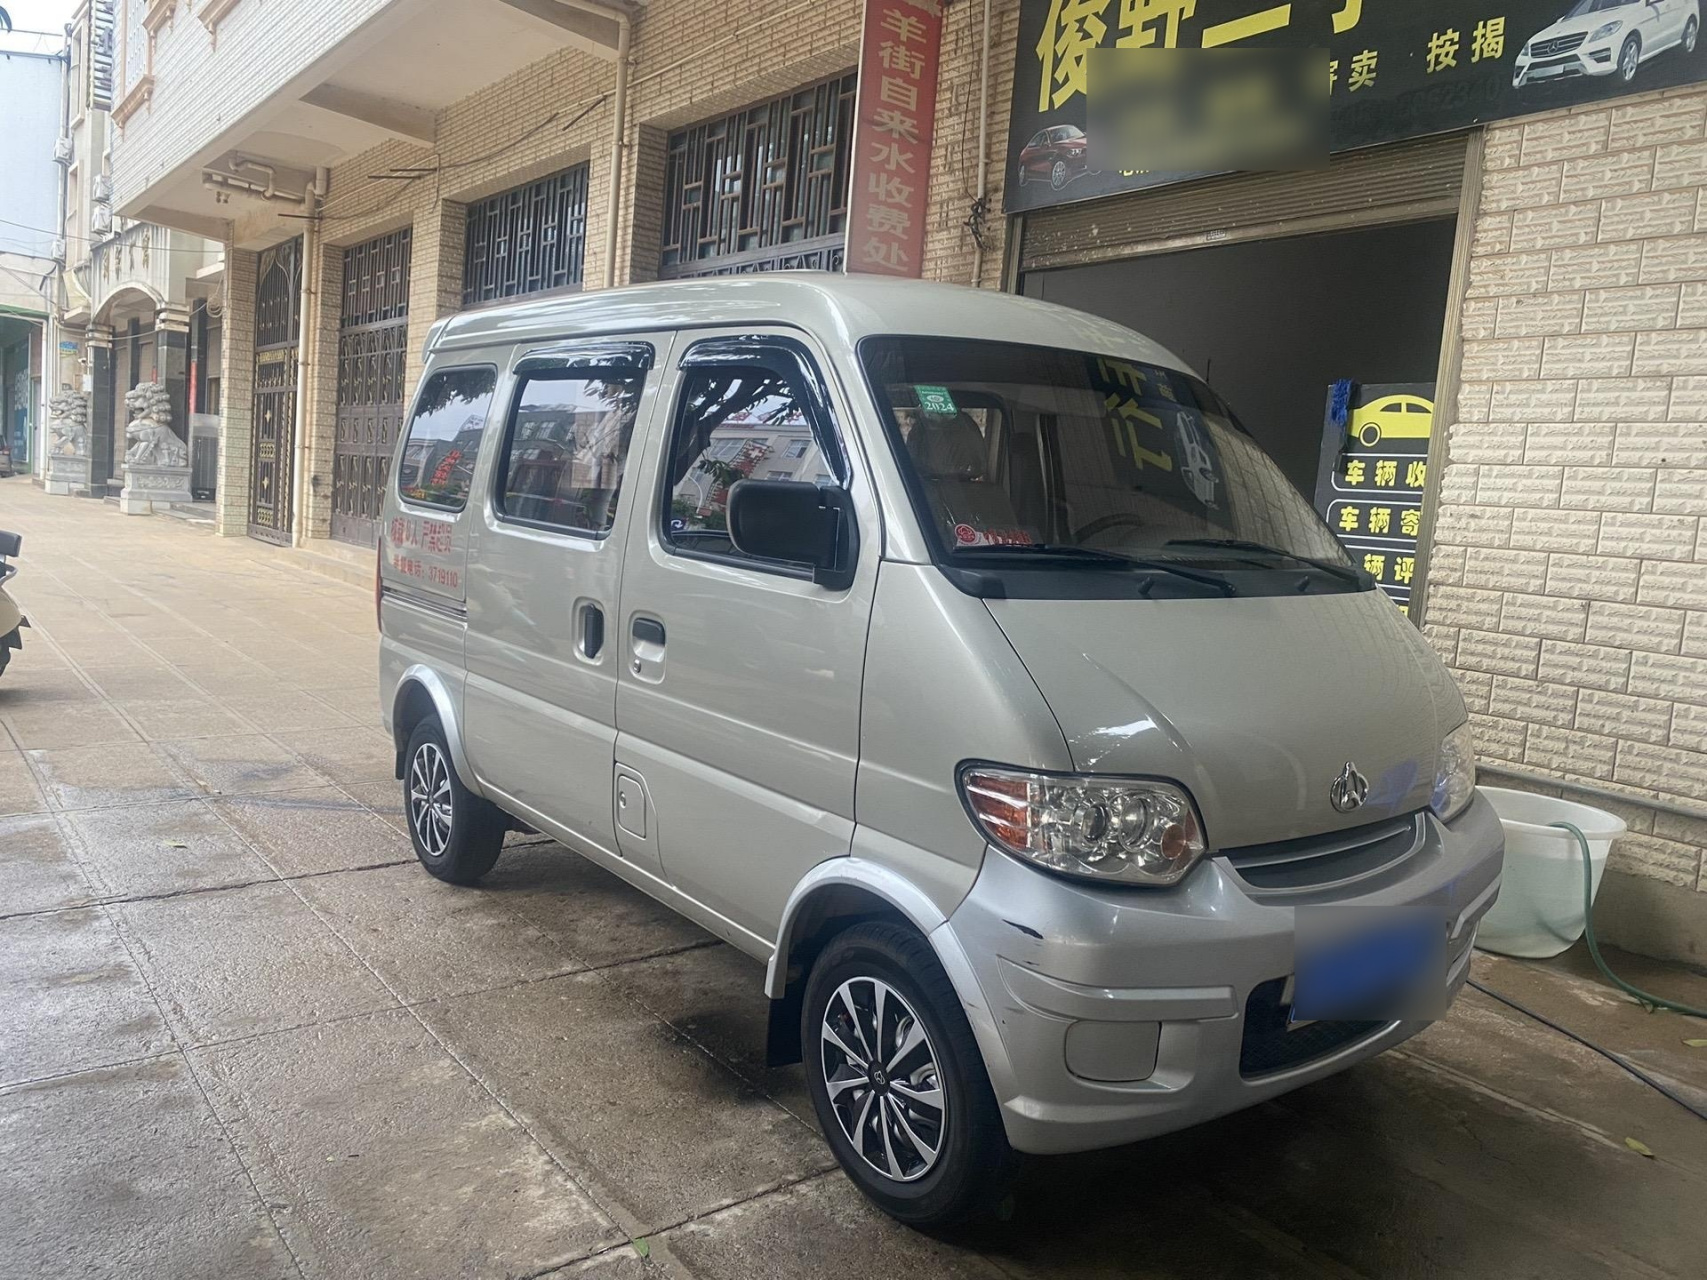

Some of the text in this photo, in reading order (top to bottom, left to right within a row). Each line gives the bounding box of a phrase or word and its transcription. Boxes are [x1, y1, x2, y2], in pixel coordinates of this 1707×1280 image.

[1426, 17, 1505, 74] 按揭
[862, 8, 927, 272] 羊街自来水收费处
[1345, 460, 1427, 488] 车辆收
[1339, 506, 1421, 536] 车辆寄
